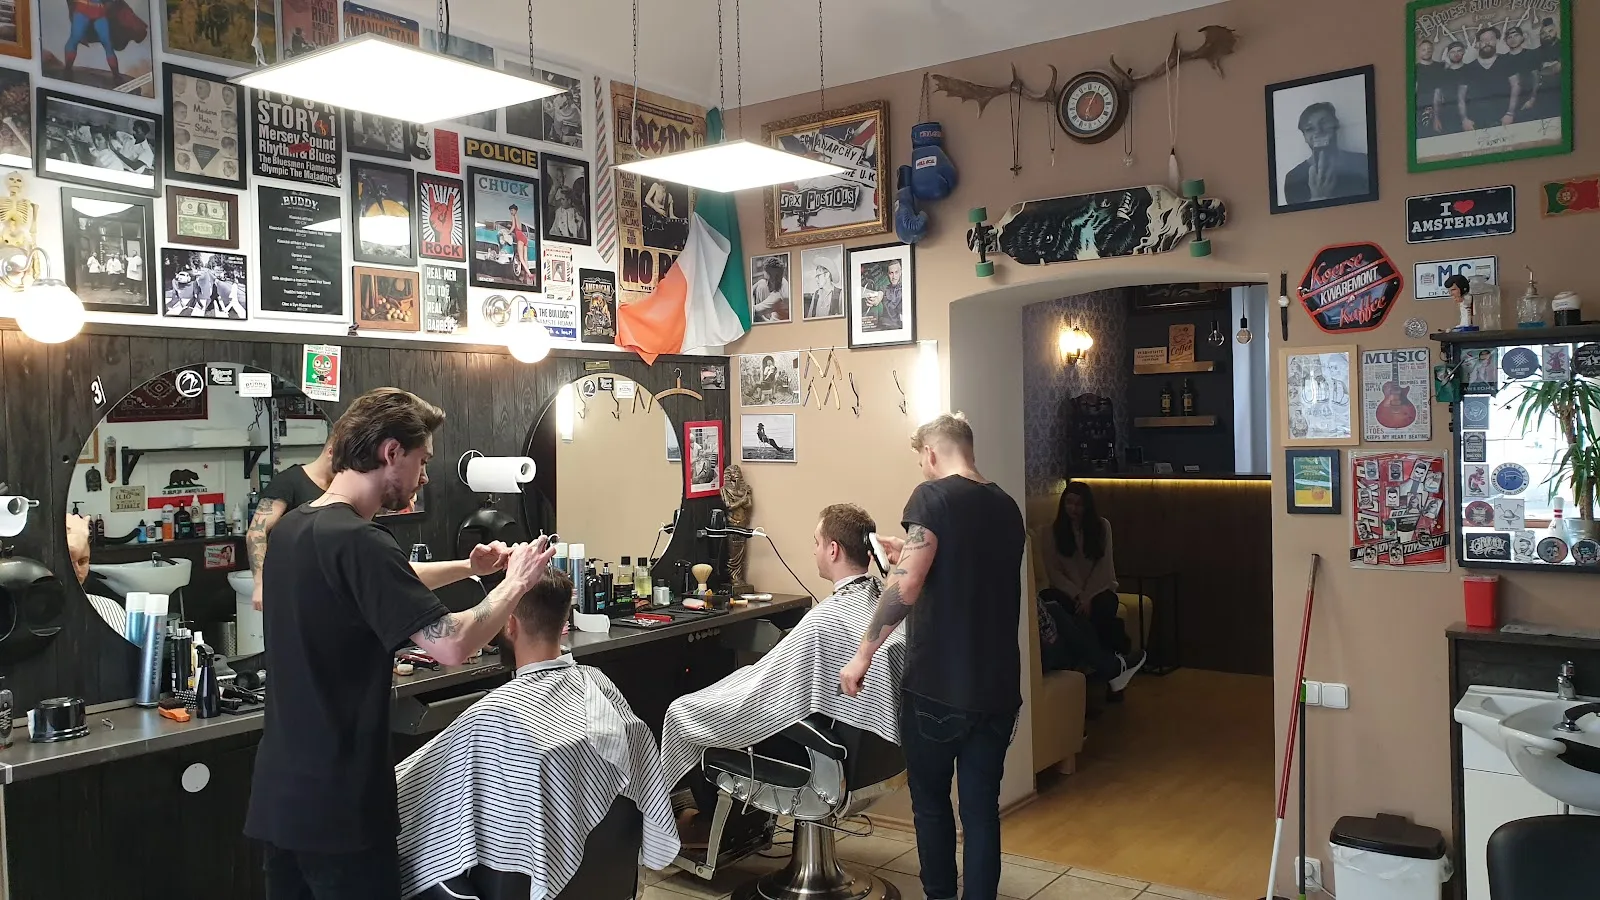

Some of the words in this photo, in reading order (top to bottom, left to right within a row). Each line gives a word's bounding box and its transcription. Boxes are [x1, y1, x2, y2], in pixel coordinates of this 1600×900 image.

[193, 103, 218, 117] Modern
[198, 114, 213, 124] Hair
[258, 100, 320, 133] STORY
[329, 115, 336, 137] 1
[194, 123, 218, 137] Styling
[258, 123, 300, 144] Mersey
[302, 131, 336, 152] Sound
[308, 147, 336, 165] Blues
[466, 139, 538, 168] POLICIE
[258, 153, 272, 164] The
[272, 156, 305, 170] Bluesmen
[306, 161, 337, 175] Flamengo
[289, 167, 303, 178] The
[478, 176, 529, 197] CHUCK
[1440, 202, 1452, 217] I
[1411, 211, 1509, 233] AMSTERDAM
[424, 241, 461, 257] ROCK
[623, 247, 653, 284] NO
[426, 266, 443, 280] REAL
[443, 268, 458, 282] MEN
[426, 284, 436, 297] GO
[1320, 266, 1379, 306] KWAREMONT
[426, 301, 443, 314] REAL
[538, 308, 548, 318] THE
[1364, 350, 1428, 365] MUSIC
[151, 632, 162, 686] PERFORMANCE
